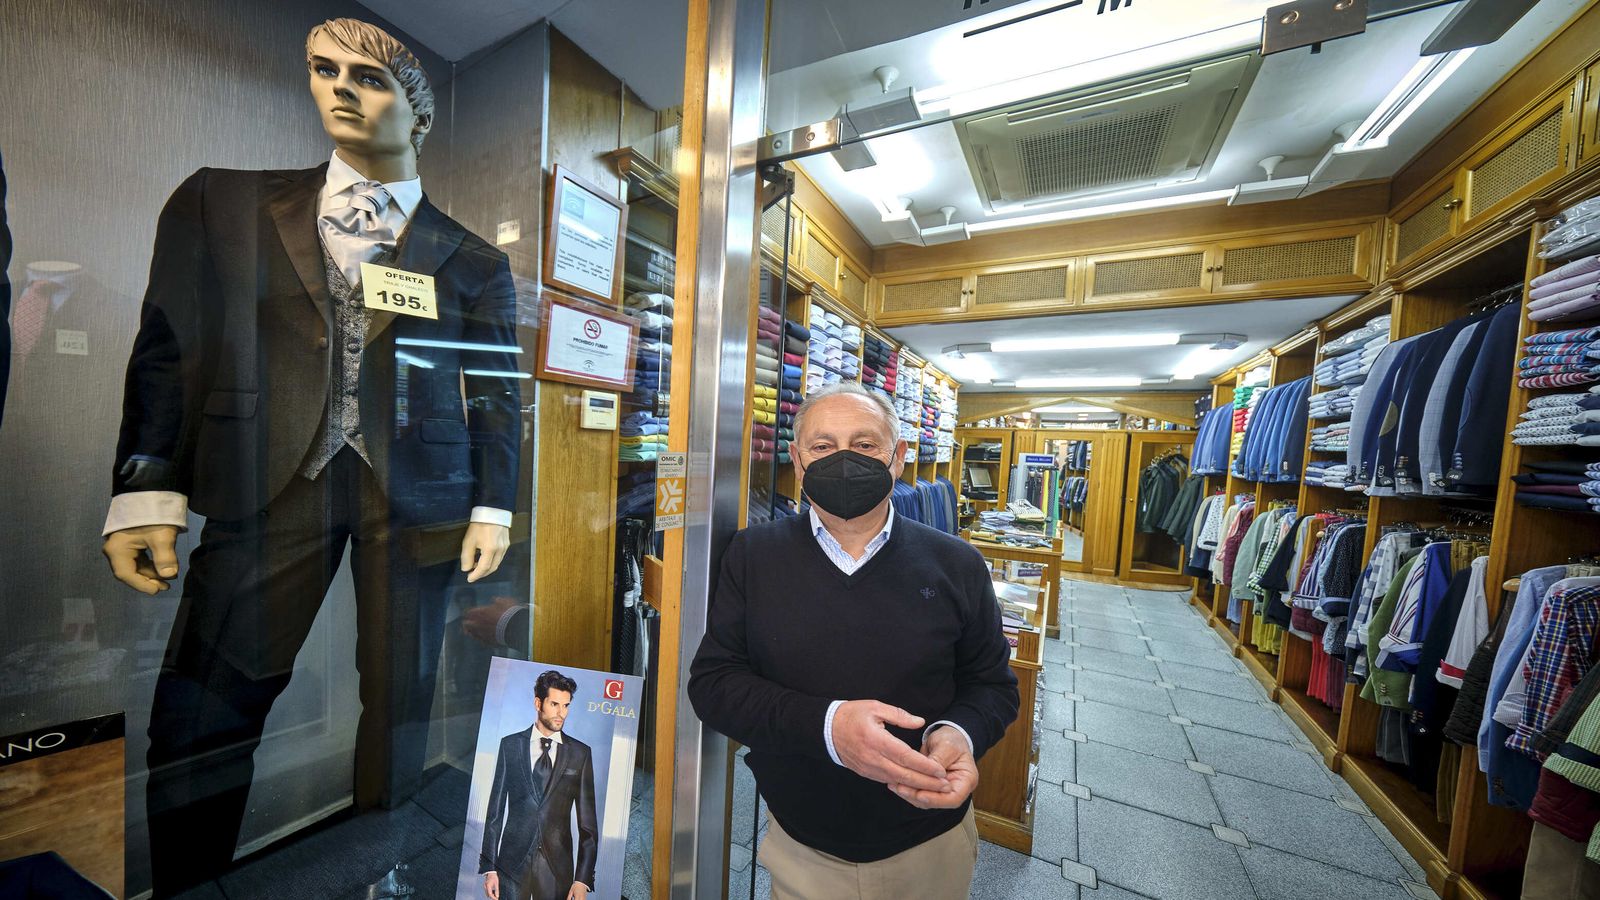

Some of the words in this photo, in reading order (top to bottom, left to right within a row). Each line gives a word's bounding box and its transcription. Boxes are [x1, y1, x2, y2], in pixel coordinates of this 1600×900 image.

[385, 271, 425, 285] OFERTA
[572, 337, 595, 347] PROHIBIDO
[605, 681, 623, 699] G
